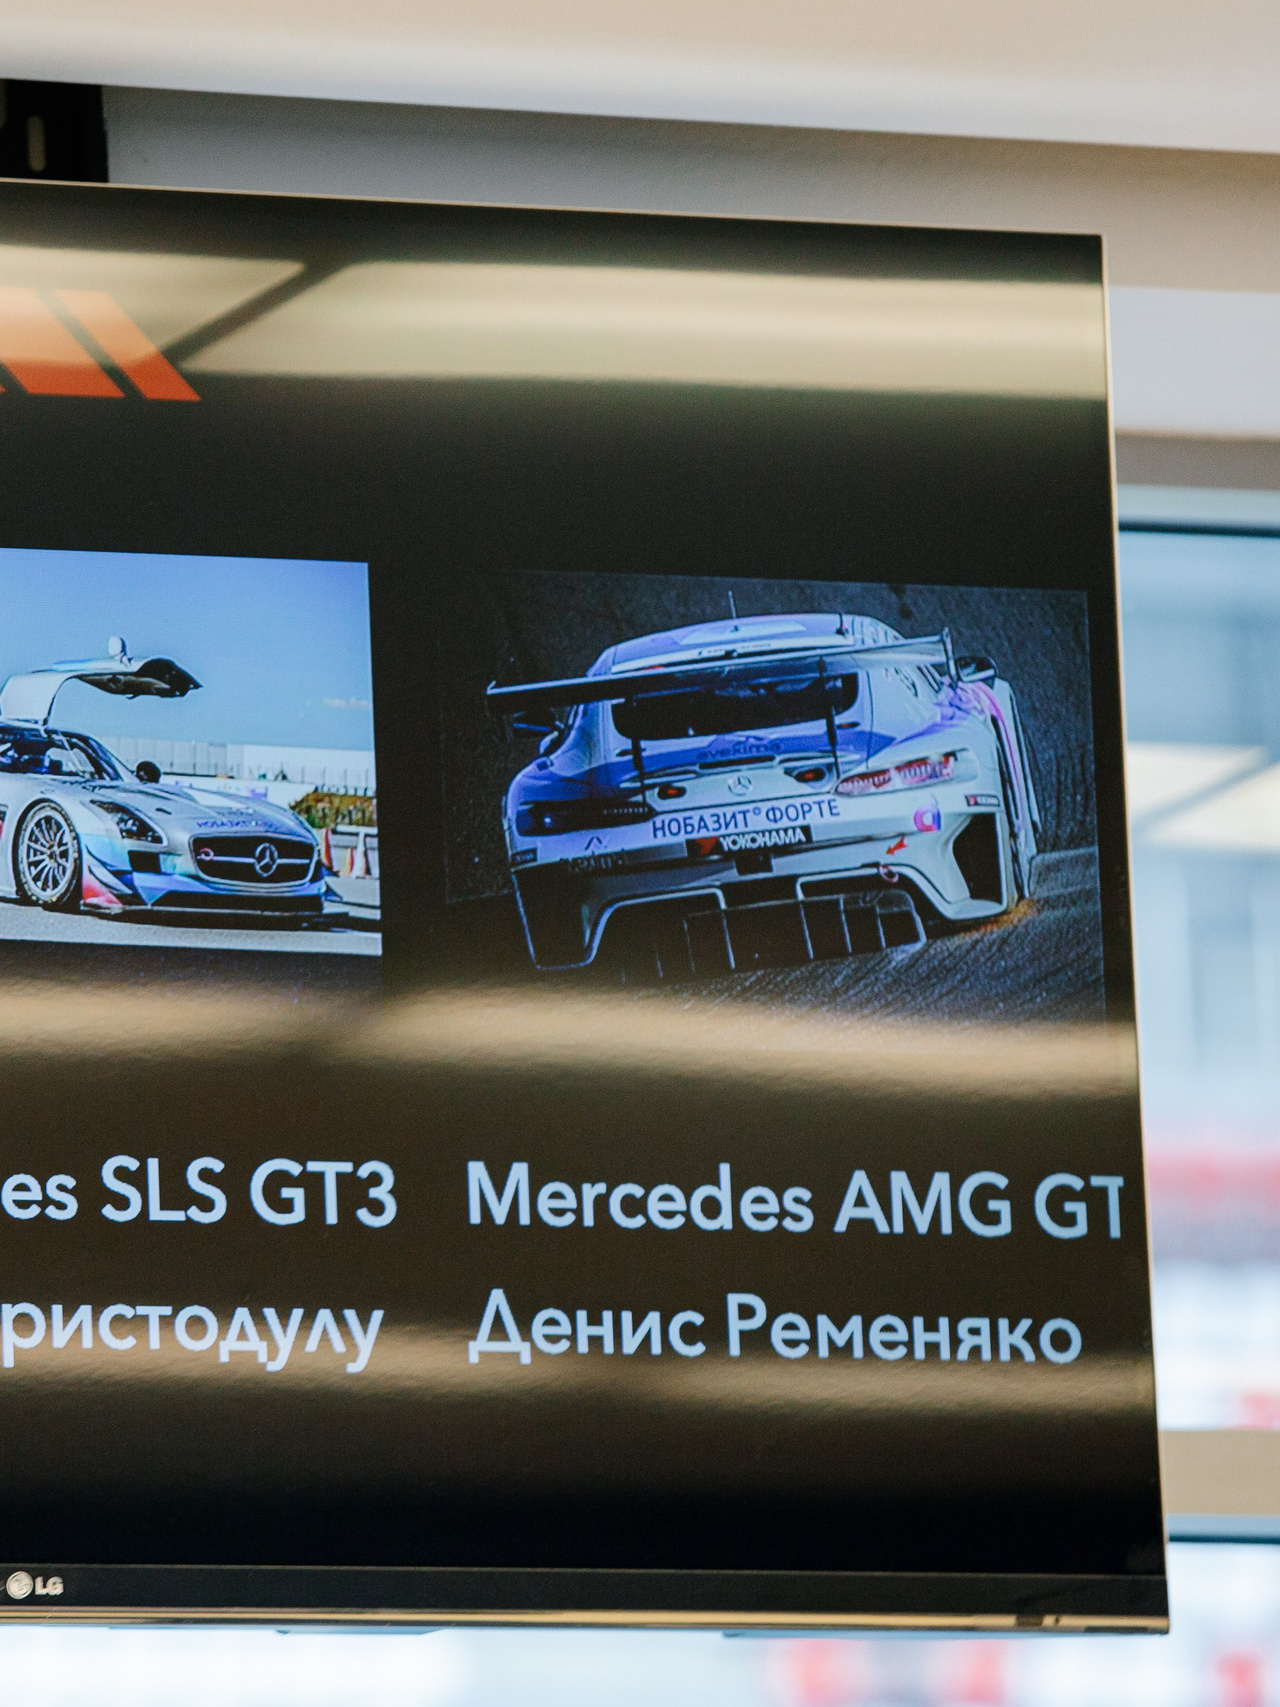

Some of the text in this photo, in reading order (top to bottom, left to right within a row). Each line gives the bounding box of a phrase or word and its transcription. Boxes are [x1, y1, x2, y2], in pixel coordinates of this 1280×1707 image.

[765, 798, 841, 824] ФОРТЕ
[719, 827, 807, 852] YOKOHAMA
[102, 1155, 226, 1223] SLS
[250, 1159, 396, 1227] GT3
[468, 1161, 1123, 1238] Mercedes AMG GT
[468, 1289, 1081, 1364] Денис Ременяко
[34, 1576, 64, 1596] LG
